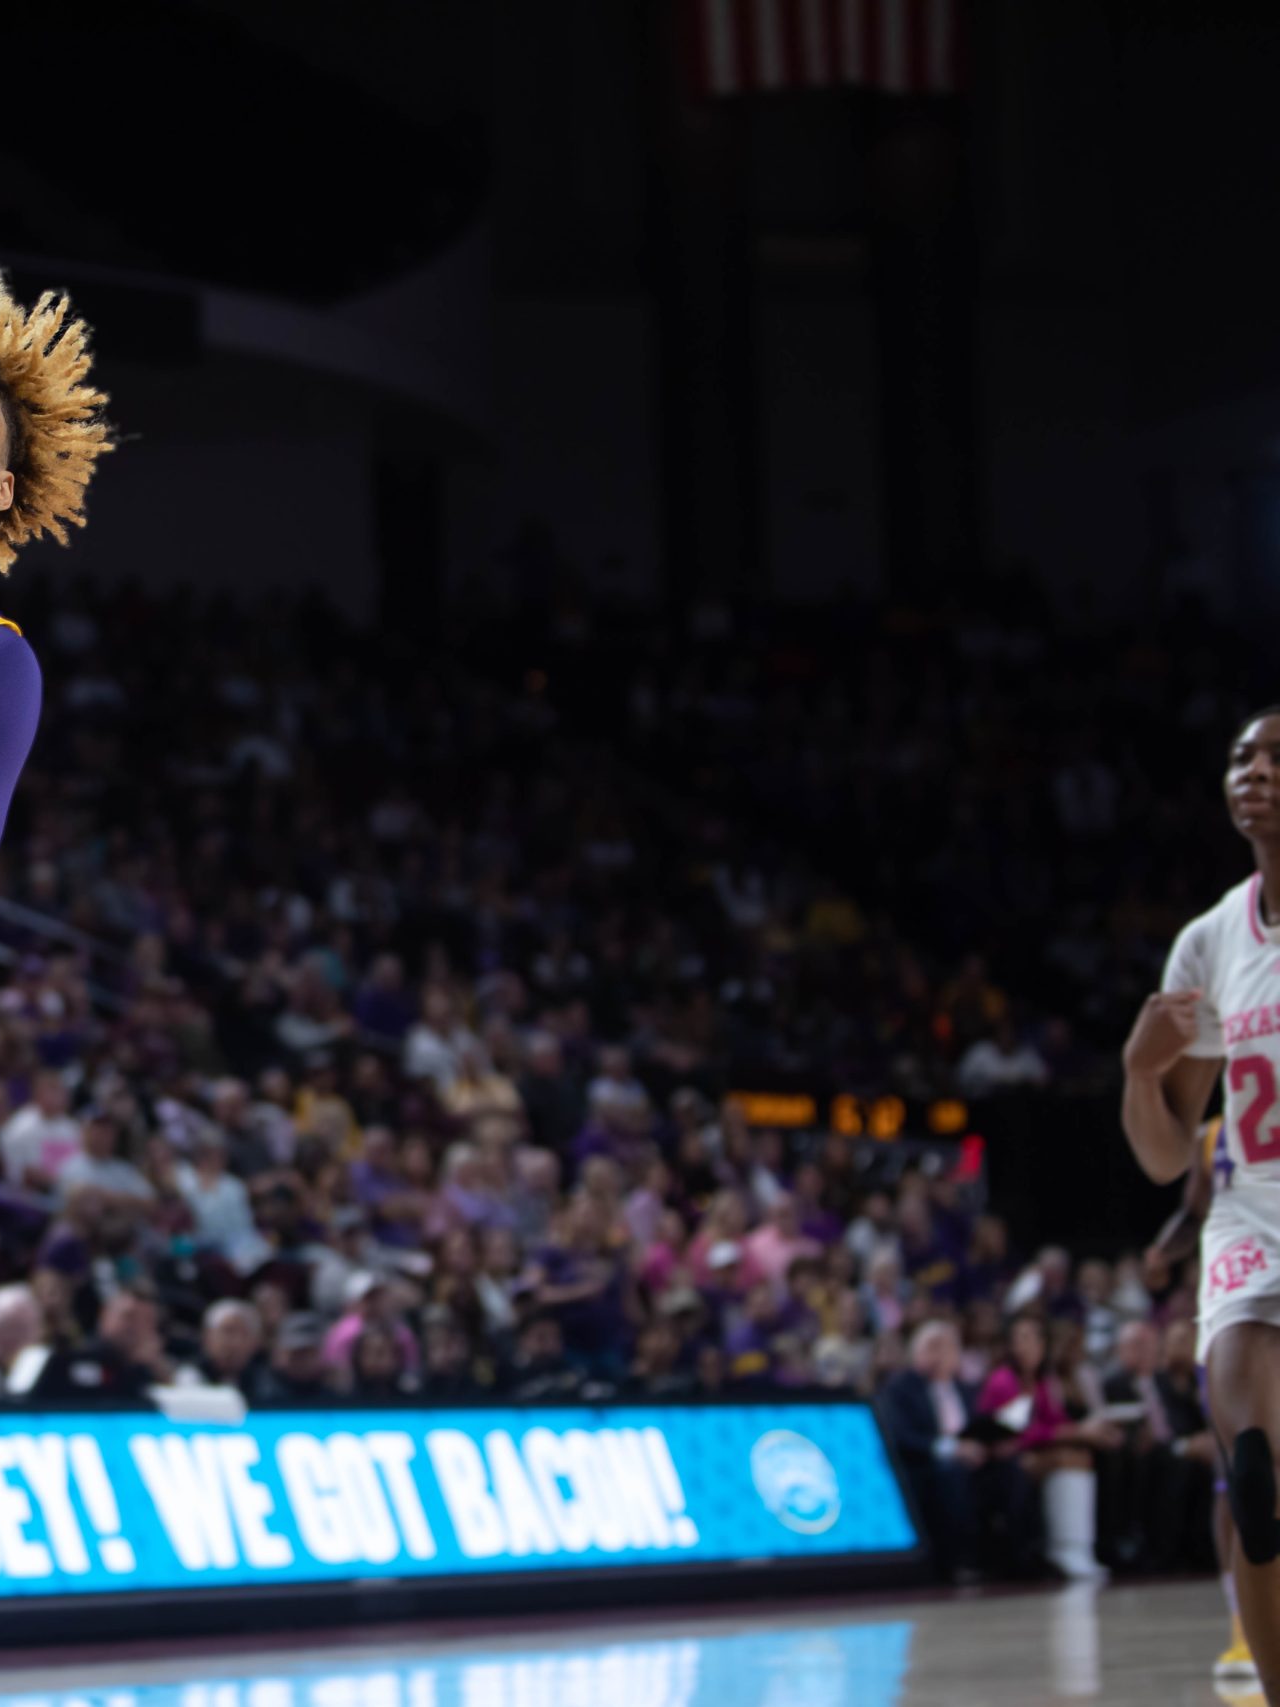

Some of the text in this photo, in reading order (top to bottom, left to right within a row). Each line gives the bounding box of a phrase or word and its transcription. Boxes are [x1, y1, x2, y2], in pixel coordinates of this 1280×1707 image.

[127, 1432, 296, 1571] WE
[274, 1429, 438, 1565] GOT
[425, 1426, 701, 1559] BACON!
